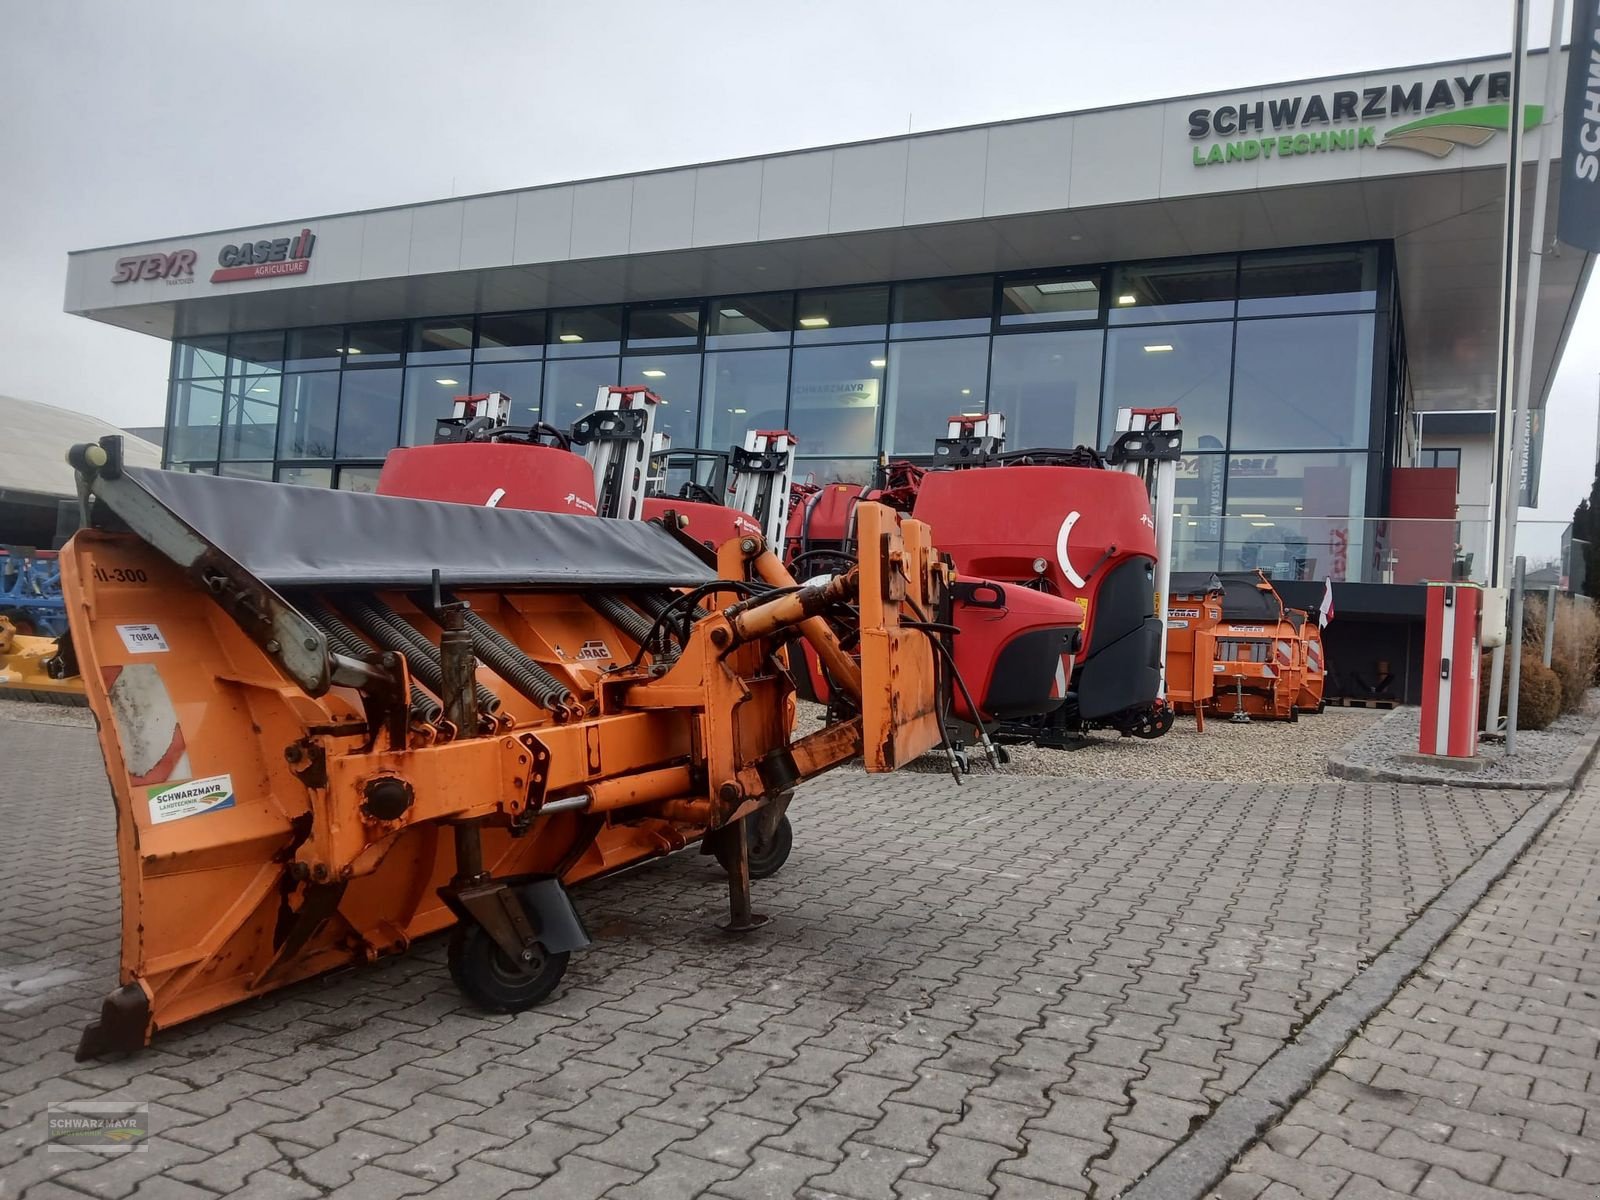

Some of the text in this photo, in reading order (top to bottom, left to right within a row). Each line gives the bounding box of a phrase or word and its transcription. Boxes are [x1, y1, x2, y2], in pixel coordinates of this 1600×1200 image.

[1188, 71, 1511, 138] SCHWARZMAYR
[1192, 125, 1377, 166] LANDTECHNIK
[111, 248, 198, 284] STEYR
[254, 262, 304, 276] AGRICULTURE
[95, 568, 147, 583] II-300
[129, 633, 160, 642] 70884
[156, 784, 221, 804] SCHWARZMAYR
[159, 798, 198, 811] LANDTECHNIK
